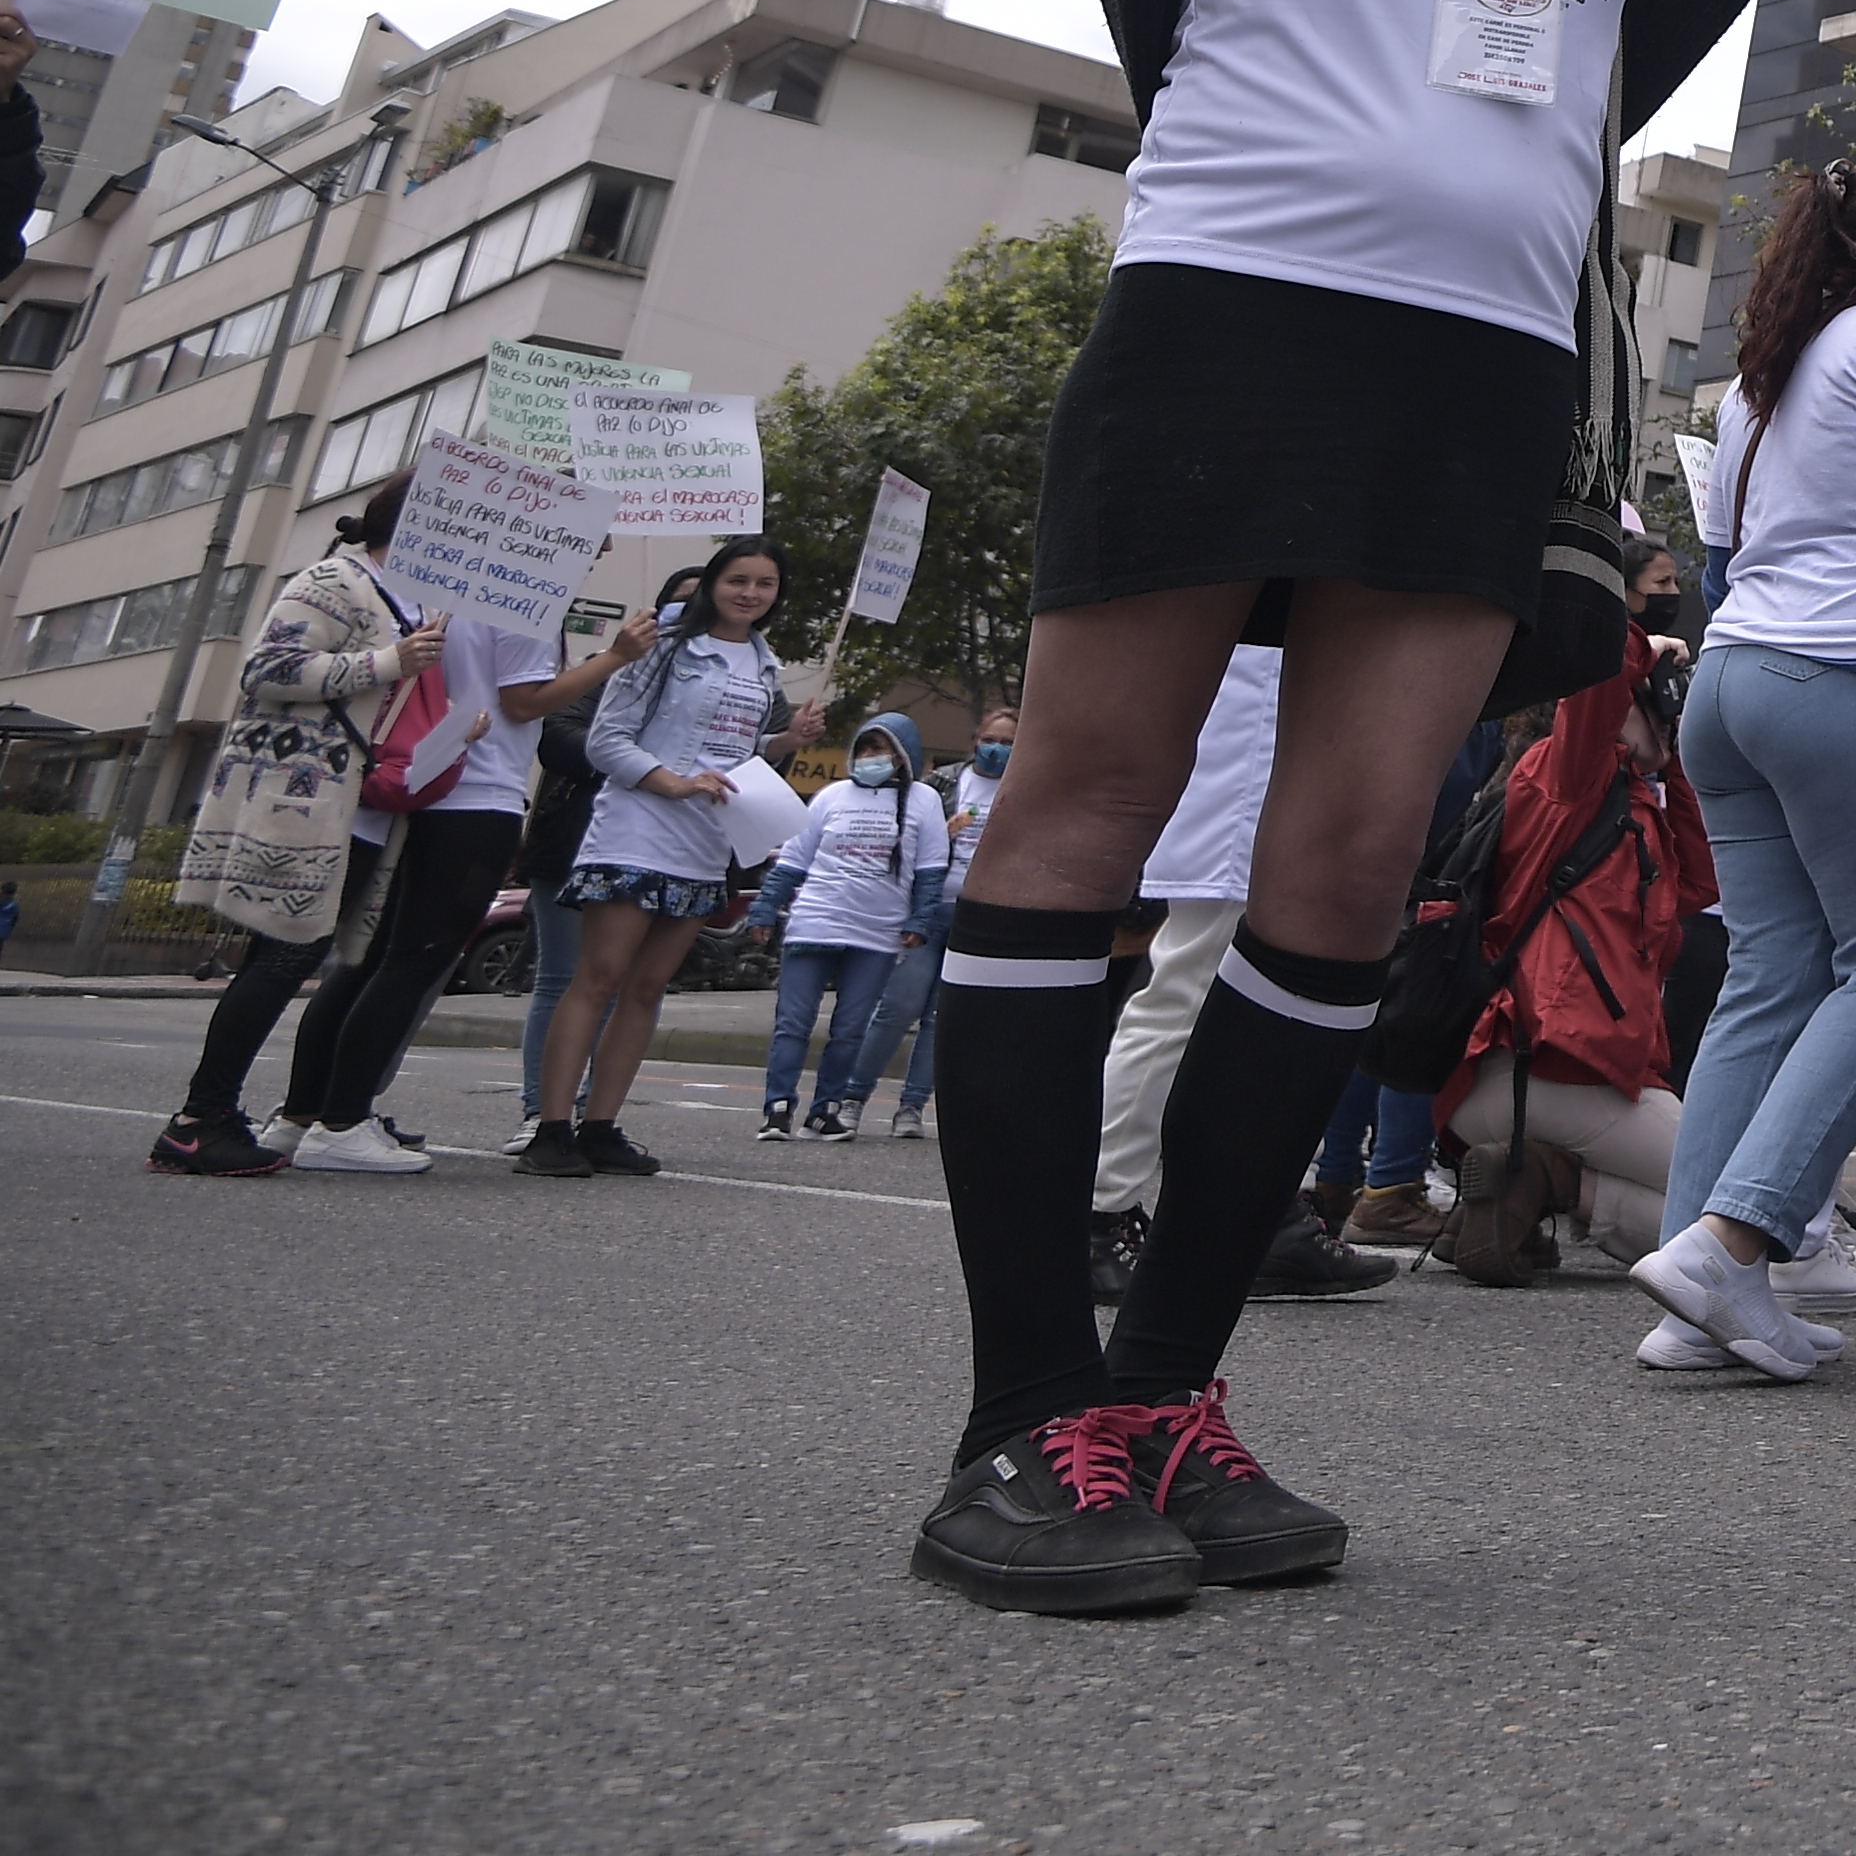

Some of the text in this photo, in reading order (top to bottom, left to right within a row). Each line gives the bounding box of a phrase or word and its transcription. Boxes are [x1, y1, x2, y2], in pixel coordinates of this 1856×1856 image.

[511, 366, 532, 382] ES
[536, 375, 571, 390] UNA
[565, 360, 631, 381] MUJERES
[515, 393, 533, 408] NO
[593, 395, 653, 412] ACUERDO
[698, 400, 724, 414] DE
[521, 429, 572, 446] SEXUA
[625, 444, 657, 460] PARA
[692, 436, 751, 458] VICTIMAS
[440, 463, 470, 486] PAZ
[447, 441, 510, 475] ACUERDO
[559, 484, 587, 502] DE
[579, 467, 598, 483] DE
[602, 463, 665, 484] VIOLENCIA
[673, 489, 759, 507] MACROCASO
[409, 481, 464, 516] JUSTICIA
[465, 502, 505, 527] PARA
[534, 524, 595, 556] VICTIMAS
[405, 507, 560, 565] DE VIOLENCIA SEXUAL
[389, 554, 405, 574] DE
[407, 558, 470, 598] VIOLENCIA
[423, 541, 464, 566] ABRA
[487, 562, 568, 599] MACROCASO
